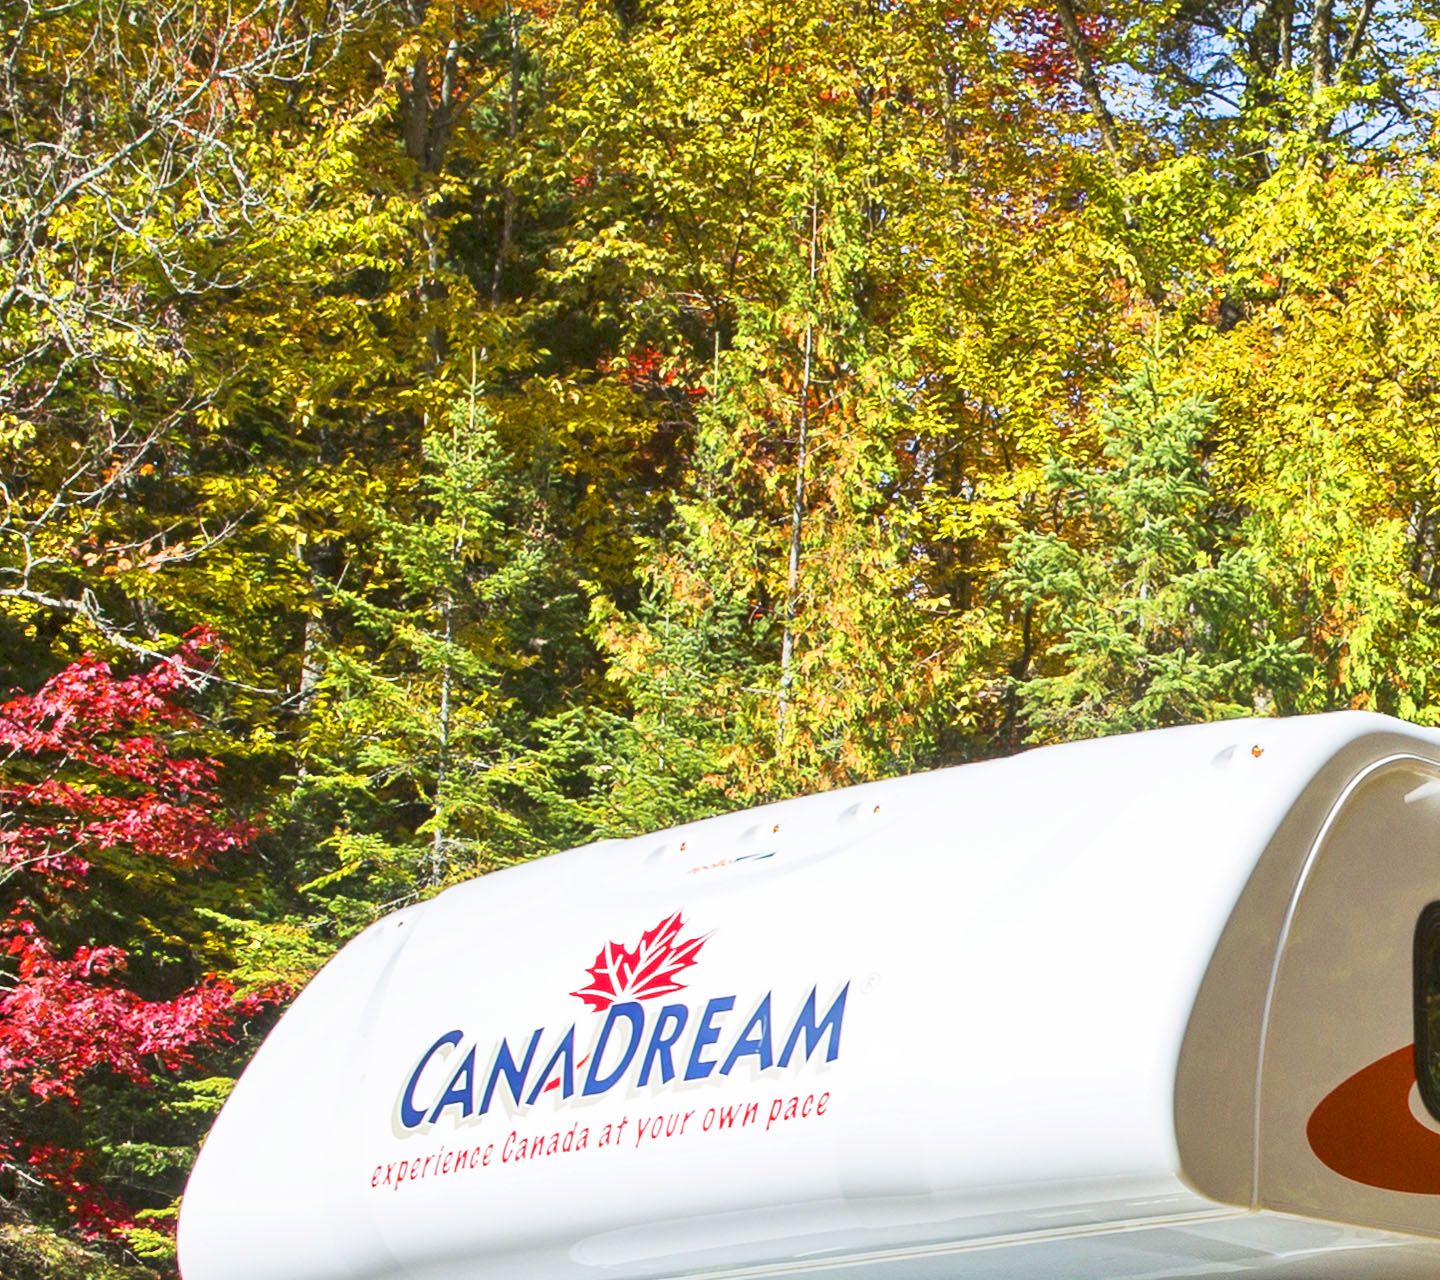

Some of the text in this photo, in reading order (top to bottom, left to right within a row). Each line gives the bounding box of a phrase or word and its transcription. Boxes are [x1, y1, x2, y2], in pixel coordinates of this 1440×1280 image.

[371, 1091, 830, 1191] experience Canada at your own pace
